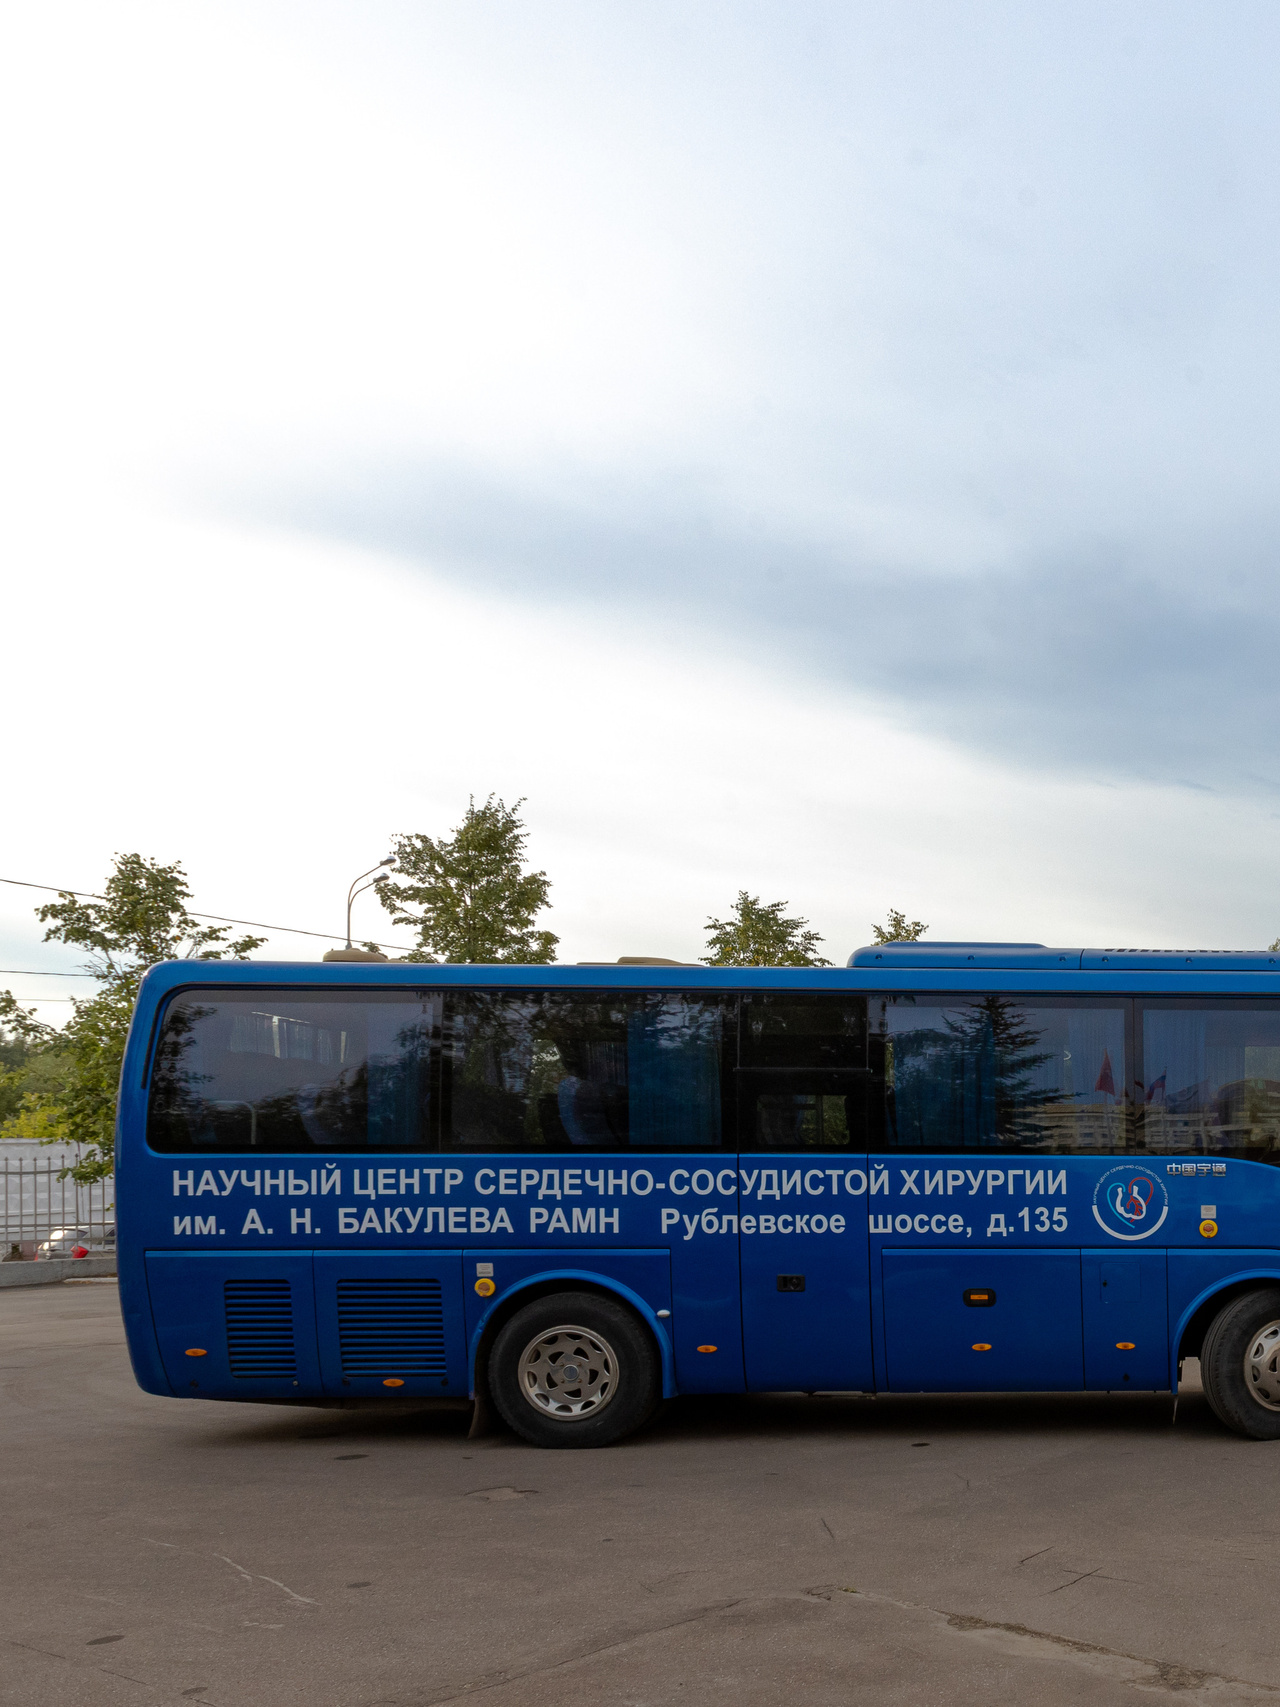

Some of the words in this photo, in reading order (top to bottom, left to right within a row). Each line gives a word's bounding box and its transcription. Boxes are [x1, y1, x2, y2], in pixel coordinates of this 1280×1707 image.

[173, 1163, 341, 1196] НАУЧНЫЙ
[353, 1168, 464, 1200] ЦЕНТР
[474, 1163, 889, 1201] СЕРДЕЧНО-СОСУДИСТОЙ
[899, 1168, 1067, 1195] ХИРУРГИИ
[1166, 1163, 1227, 1177] 中国宇通
[174, 1215, 226, 1235] им.
[241, 1208, 273, 1235] А.
[290, 1208, 321, 1234] Н.
[338, 1207, 514, 1234] БАКУЛЕВА
[530, 1207, 619, 1234] РАМН
[661, 1207, 846, 1241] Рублевское
[868, 1214, 972, 1238] шоссе,
[986, 1206, 1068, 1237] д.135
